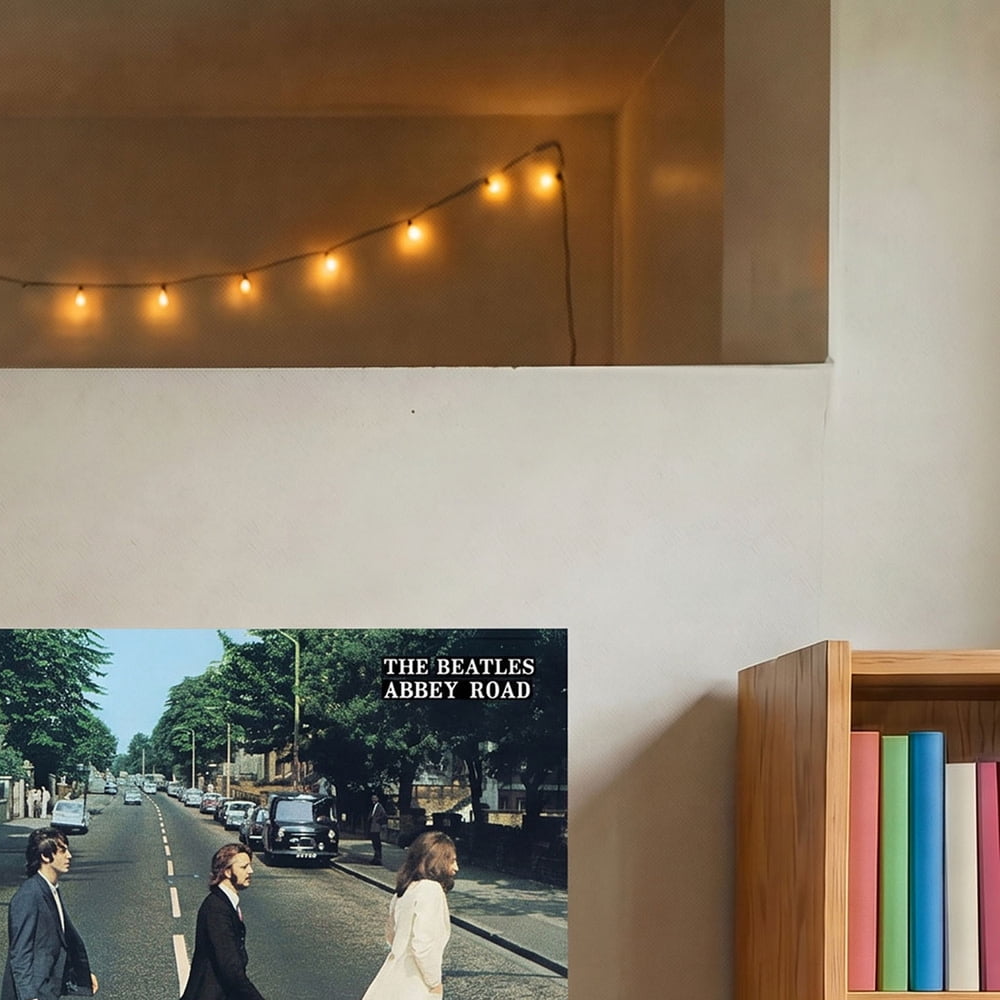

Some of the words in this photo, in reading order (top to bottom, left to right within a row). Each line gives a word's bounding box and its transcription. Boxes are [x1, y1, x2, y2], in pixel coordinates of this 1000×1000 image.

[383, 658, 429, 675] THE
[436, 658, 535, 675] BEATLES
[383, 680, 459, 699] ABBEY
[469, 680, 531, 699] ROAD
